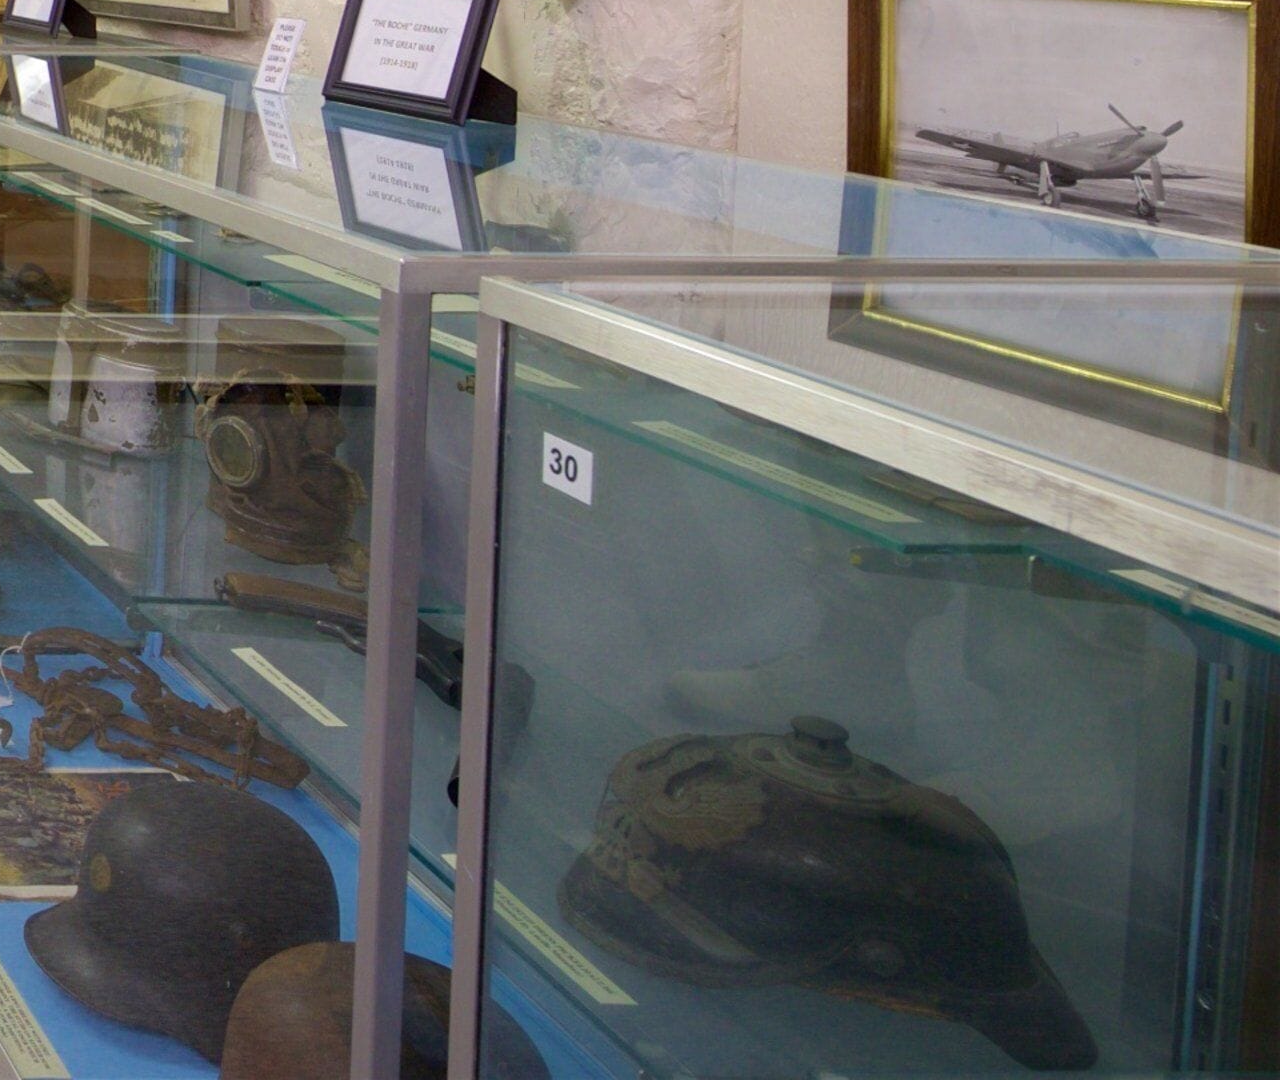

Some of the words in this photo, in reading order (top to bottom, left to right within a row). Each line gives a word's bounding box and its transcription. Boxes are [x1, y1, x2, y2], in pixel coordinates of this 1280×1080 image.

[413, 23, 448, 34] GERMANY
[382, 39, 394, 47] THE
[396, 41, 417, 50] GREAT
[418, 44, 435, 52] WAR
[549, 447, 578, 482] 30
